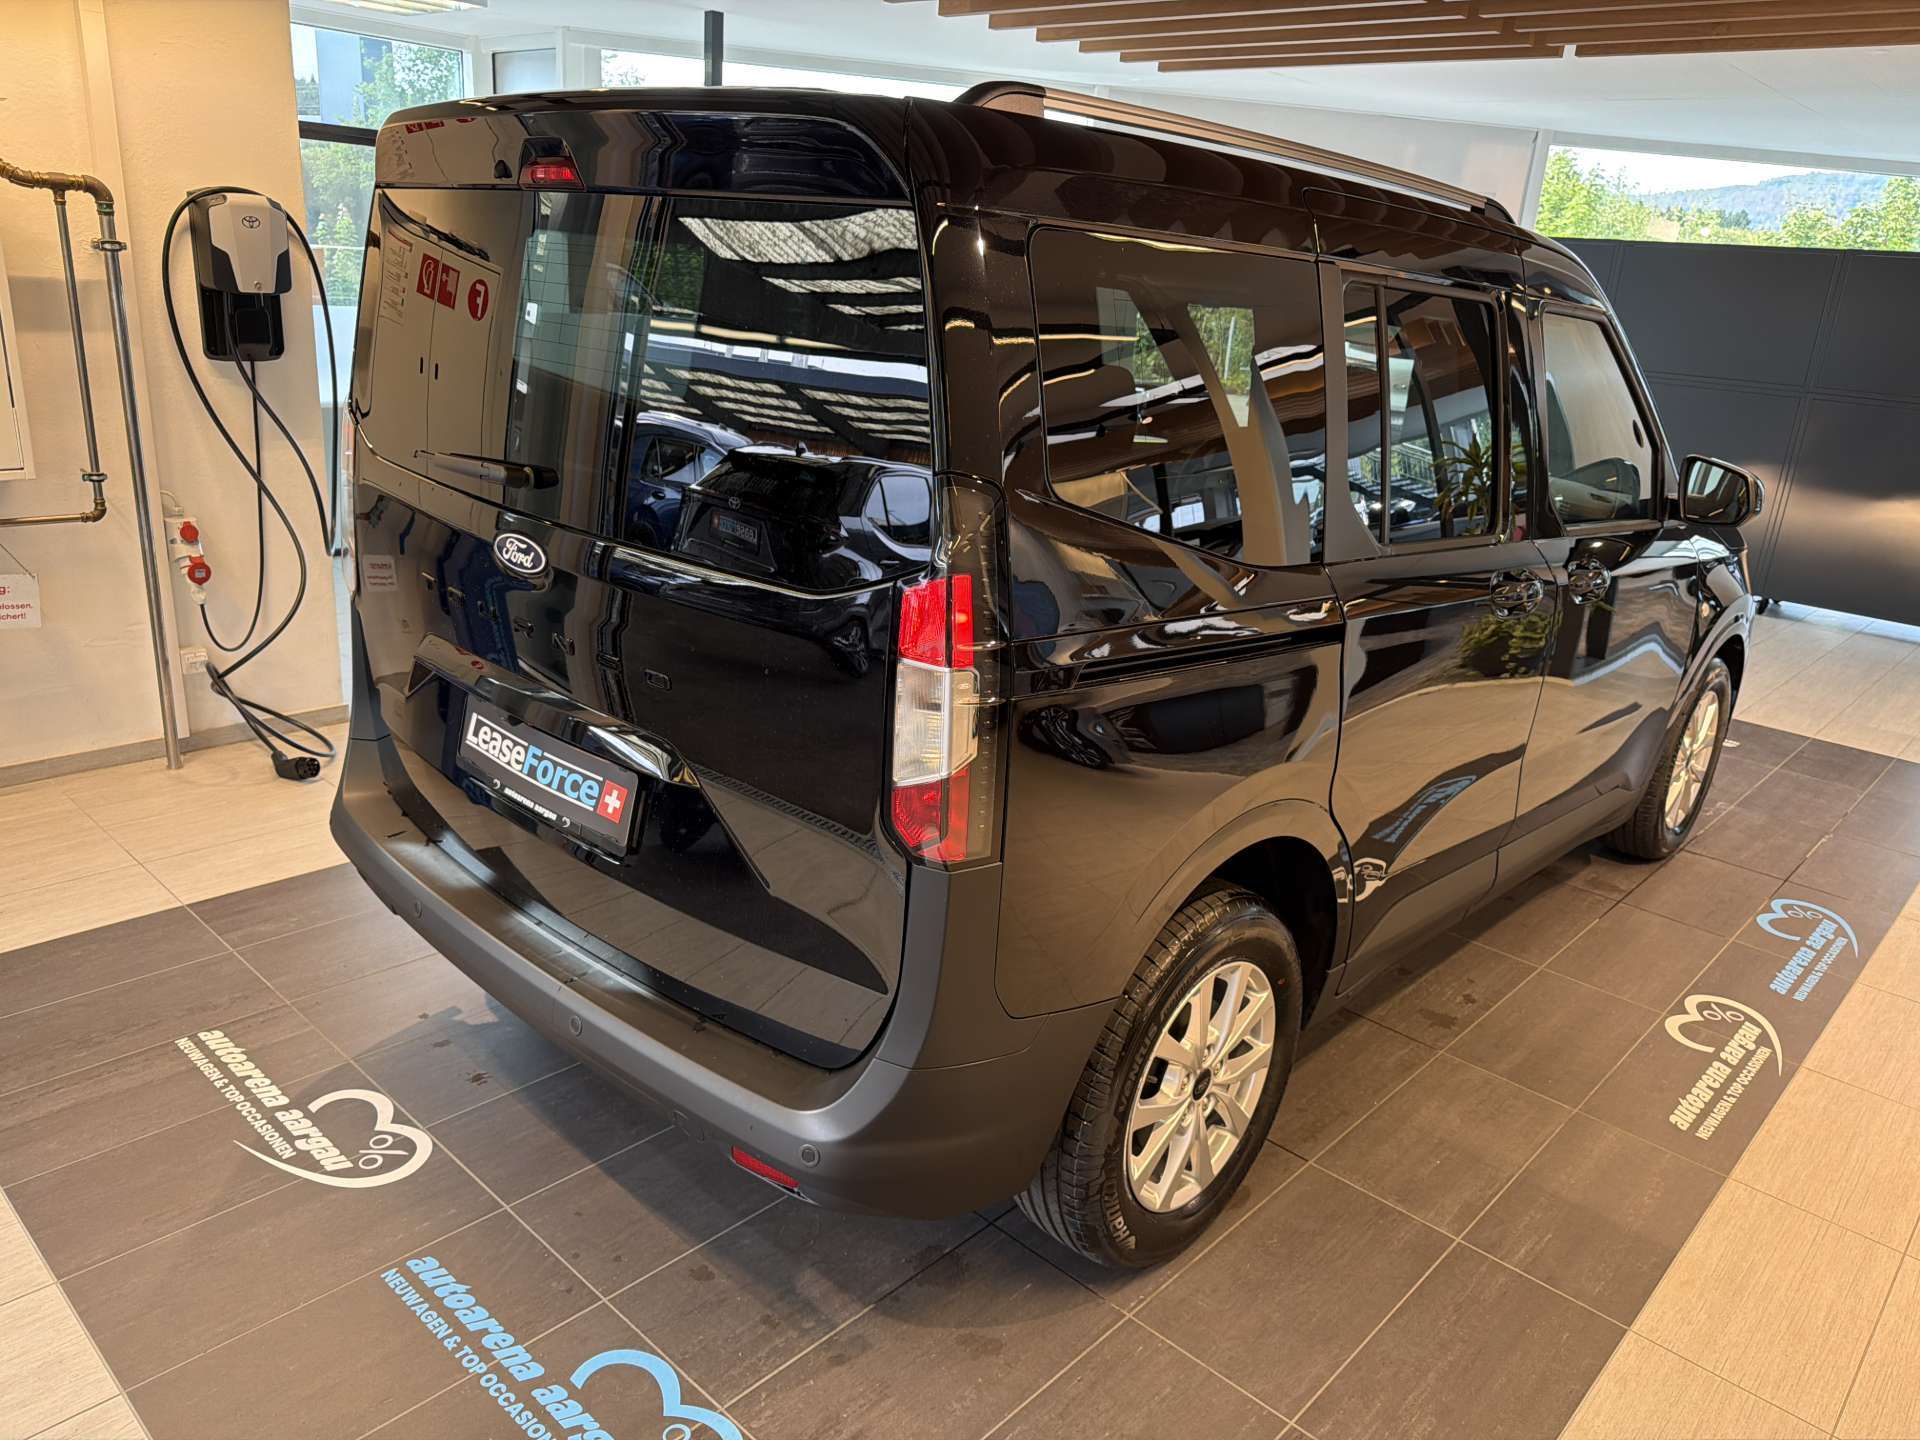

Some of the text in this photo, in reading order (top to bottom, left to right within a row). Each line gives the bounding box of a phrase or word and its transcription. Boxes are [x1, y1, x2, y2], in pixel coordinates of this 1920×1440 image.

[501, 538, 533, 568] Ford
[466, 712, 600, 806] LeaseForce
[1769, 946, 1817, 995] autoarena
[174, 1037, 297, 1160] NEUWAGEN & TOP OCCASIONEN
[197, 1030, 354, 1172] autoarena aargau
[1669, 1021, 1763, 1131] autoarena aargau
[1695, 1099, 1734, 1141] NEUWAGEN
[1726, 1082, 1745, 1098] TOP
[1736, 1045, 1773, 1085] OCCASIONEN
[380, 1268, 454, 1340] NEUWAGEN
[444, 1335, 462, 1351] &
[455, 1345, 489, 1375] TOP
[405, 1256, 545, 1382] autoarena
